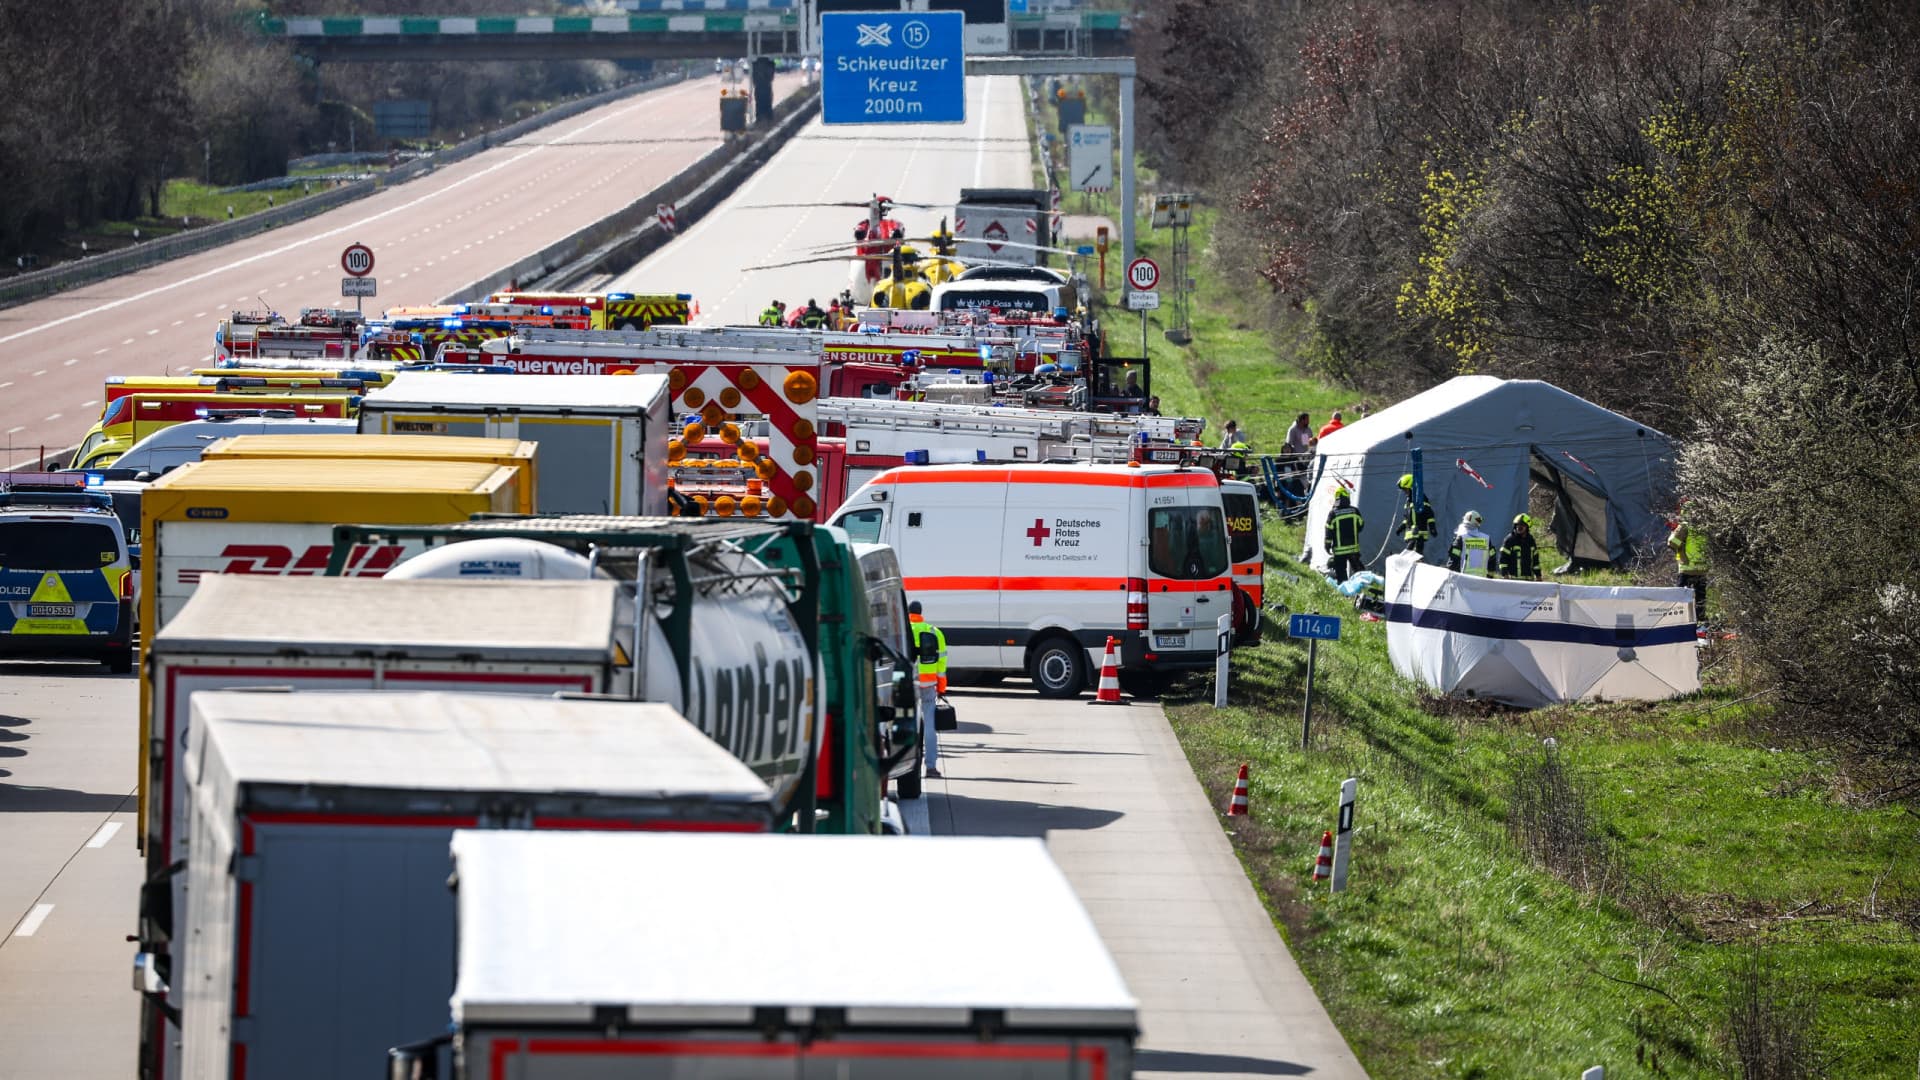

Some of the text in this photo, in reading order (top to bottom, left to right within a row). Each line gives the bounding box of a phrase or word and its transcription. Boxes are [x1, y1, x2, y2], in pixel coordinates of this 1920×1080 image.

[908, 27, 923, 42] 15
[837, 56, 948, 72] Schkeuditzer
[868, 77, 918, 93] Kreuz
[348, 252, 368, 268] 100
[1134, 267, 1154, 281] 100
[977, 299, 1012, 308] VIP Class
[492, 355, 605, 376] Feuerwehr
[395, 422, 433, 432] WIELTON
[1056, 518, 1101, 528] Deutsches
[1232, 517, 1252, 531] ASB
[1055, 528, 1081, 537] Rotes
[1054, 539, 1081, 547] Kreuz
[460, 561, 522, 569] CIMC TANK
